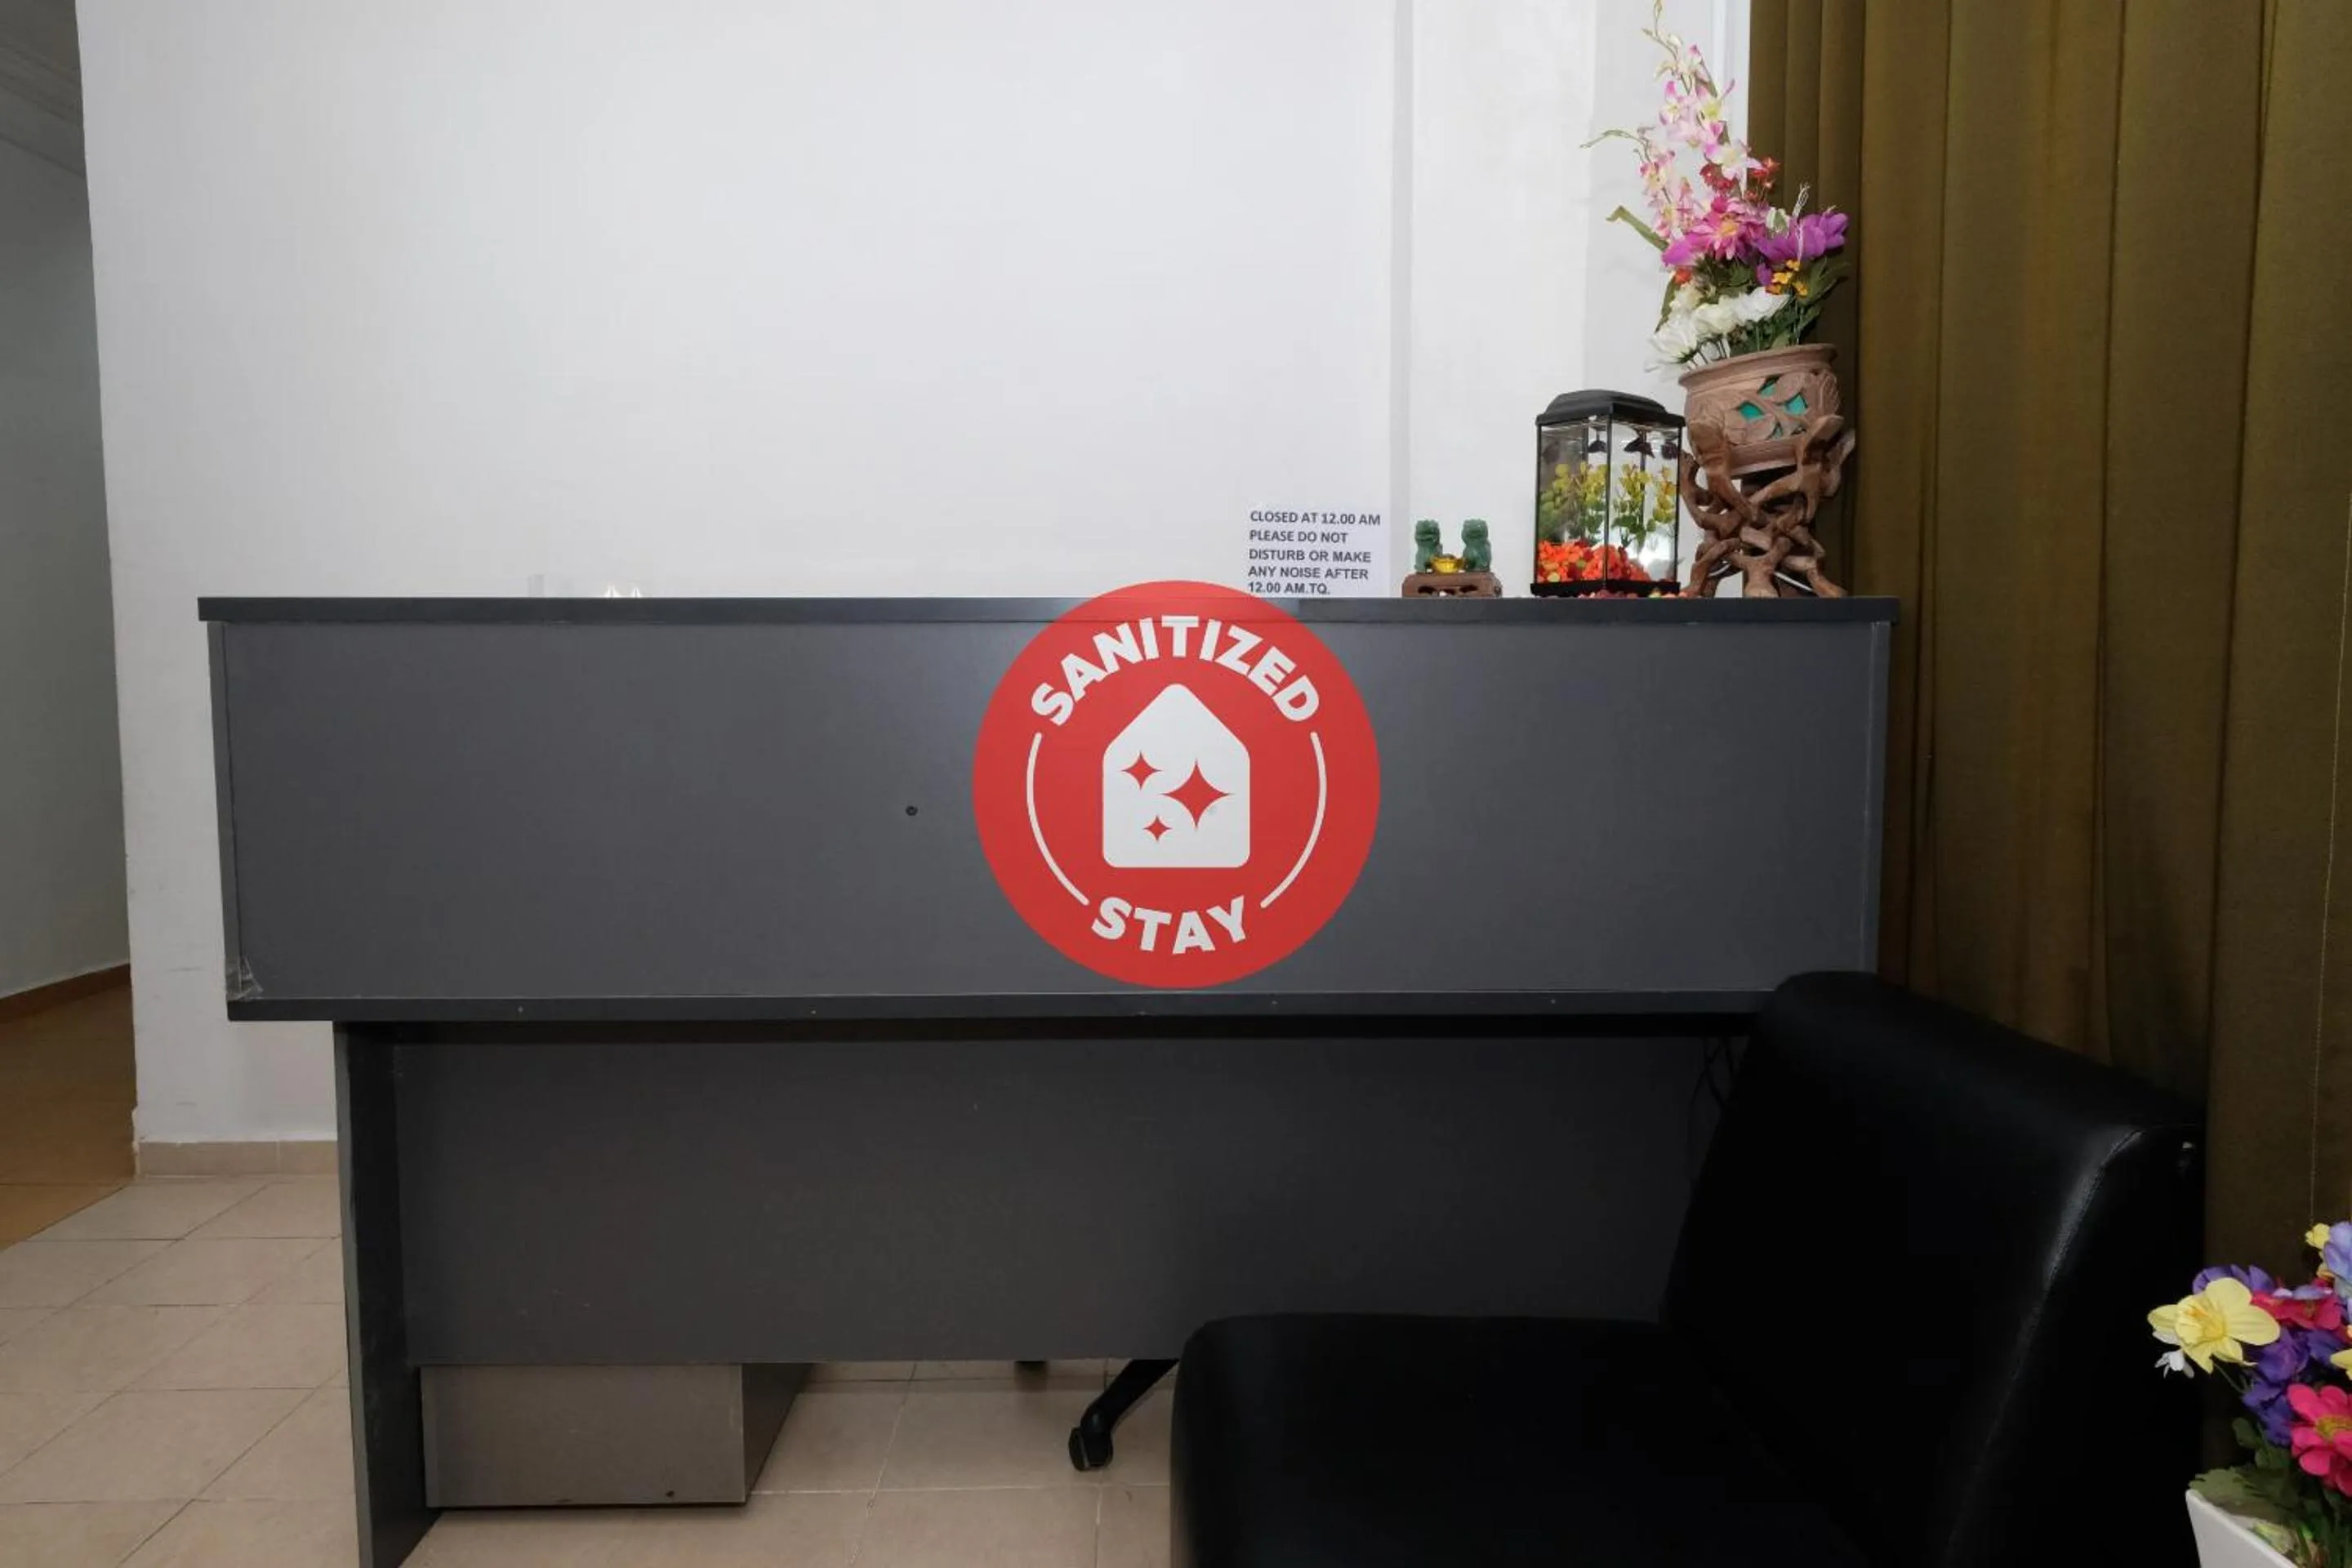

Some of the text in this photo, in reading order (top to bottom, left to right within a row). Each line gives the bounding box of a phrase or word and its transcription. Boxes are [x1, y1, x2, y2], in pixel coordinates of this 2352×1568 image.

[1250, 510, 1381, 525] CLOSED AT 12.00 AM
[1250, 529, 1349, 544] PLEASE DO NOT
[1249, 549, 1372, 564] DISTURB OR MAKE
[1248, 565, 1369, 580] ANY NOISE AFTER
[1249, 581, 1281, 594] 12.00
